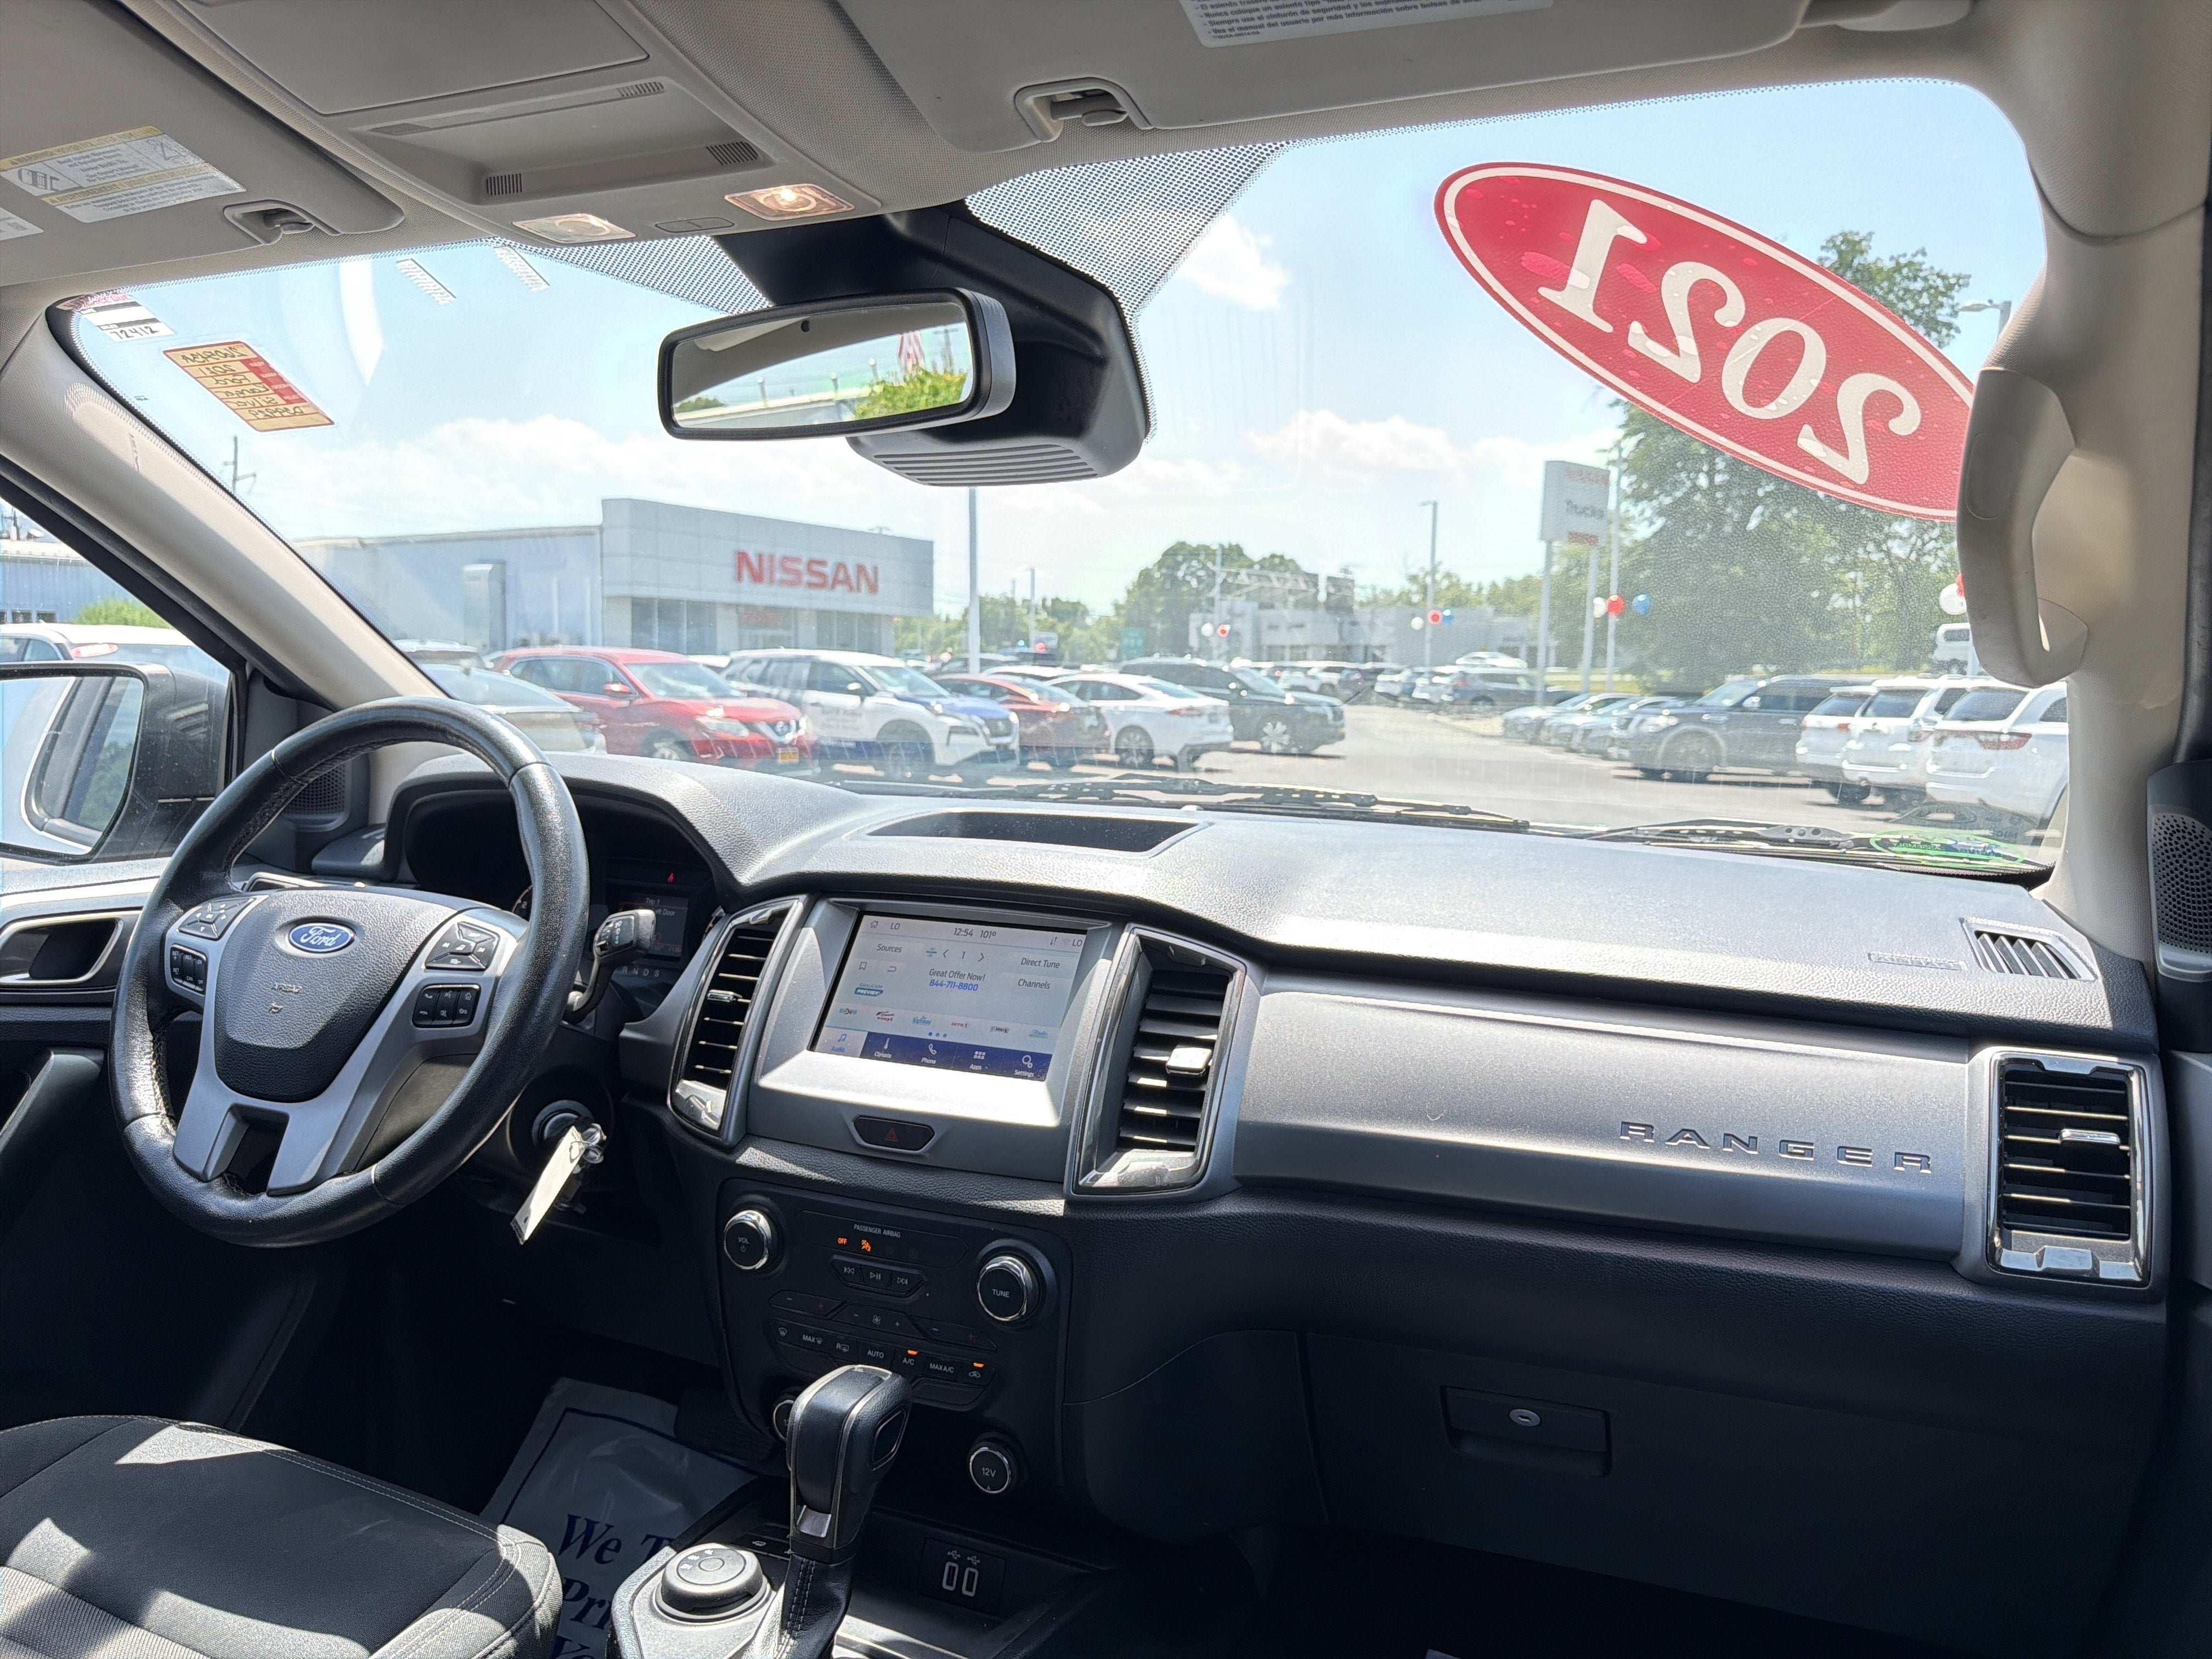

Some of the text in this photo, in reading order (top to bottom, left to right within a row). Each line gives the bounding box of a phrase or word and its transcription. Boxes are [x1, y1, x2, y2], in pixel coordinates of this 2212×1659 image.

[110, 325, 160, 340] 72412
[735, 550, 879, 595] NISSAN
[300, 926, 342, 946] Ford
[954, 928, 973, 937] 12:54
[877, 944, 902, 953] Sources
[1071, 939, 1082, 947] LO
[1021, 957, 1060, 969] Direct Tune
[929, 968, 986, 981] Great Offer Now!
[929, 979, 979, 991] 844-711-8800
[1018, 979, 1051, 989] Channels
[1014, 1069, 1034, 1077] Settings
[1620, 1121, 1931, 1173] RANGER
[854, 1223, 901, 1238] PASSENGER AIRBAG
[992, 1289, 1010, 1298] TUNE
[803, 1334, 815, 1343] MAX
[867, 1349, 884, 1358] AUTO
[902, 1357, 915, 1365] A/C
[981, 1466, 996, 1477] 12V
[558, 1514, 623, 1565] We
